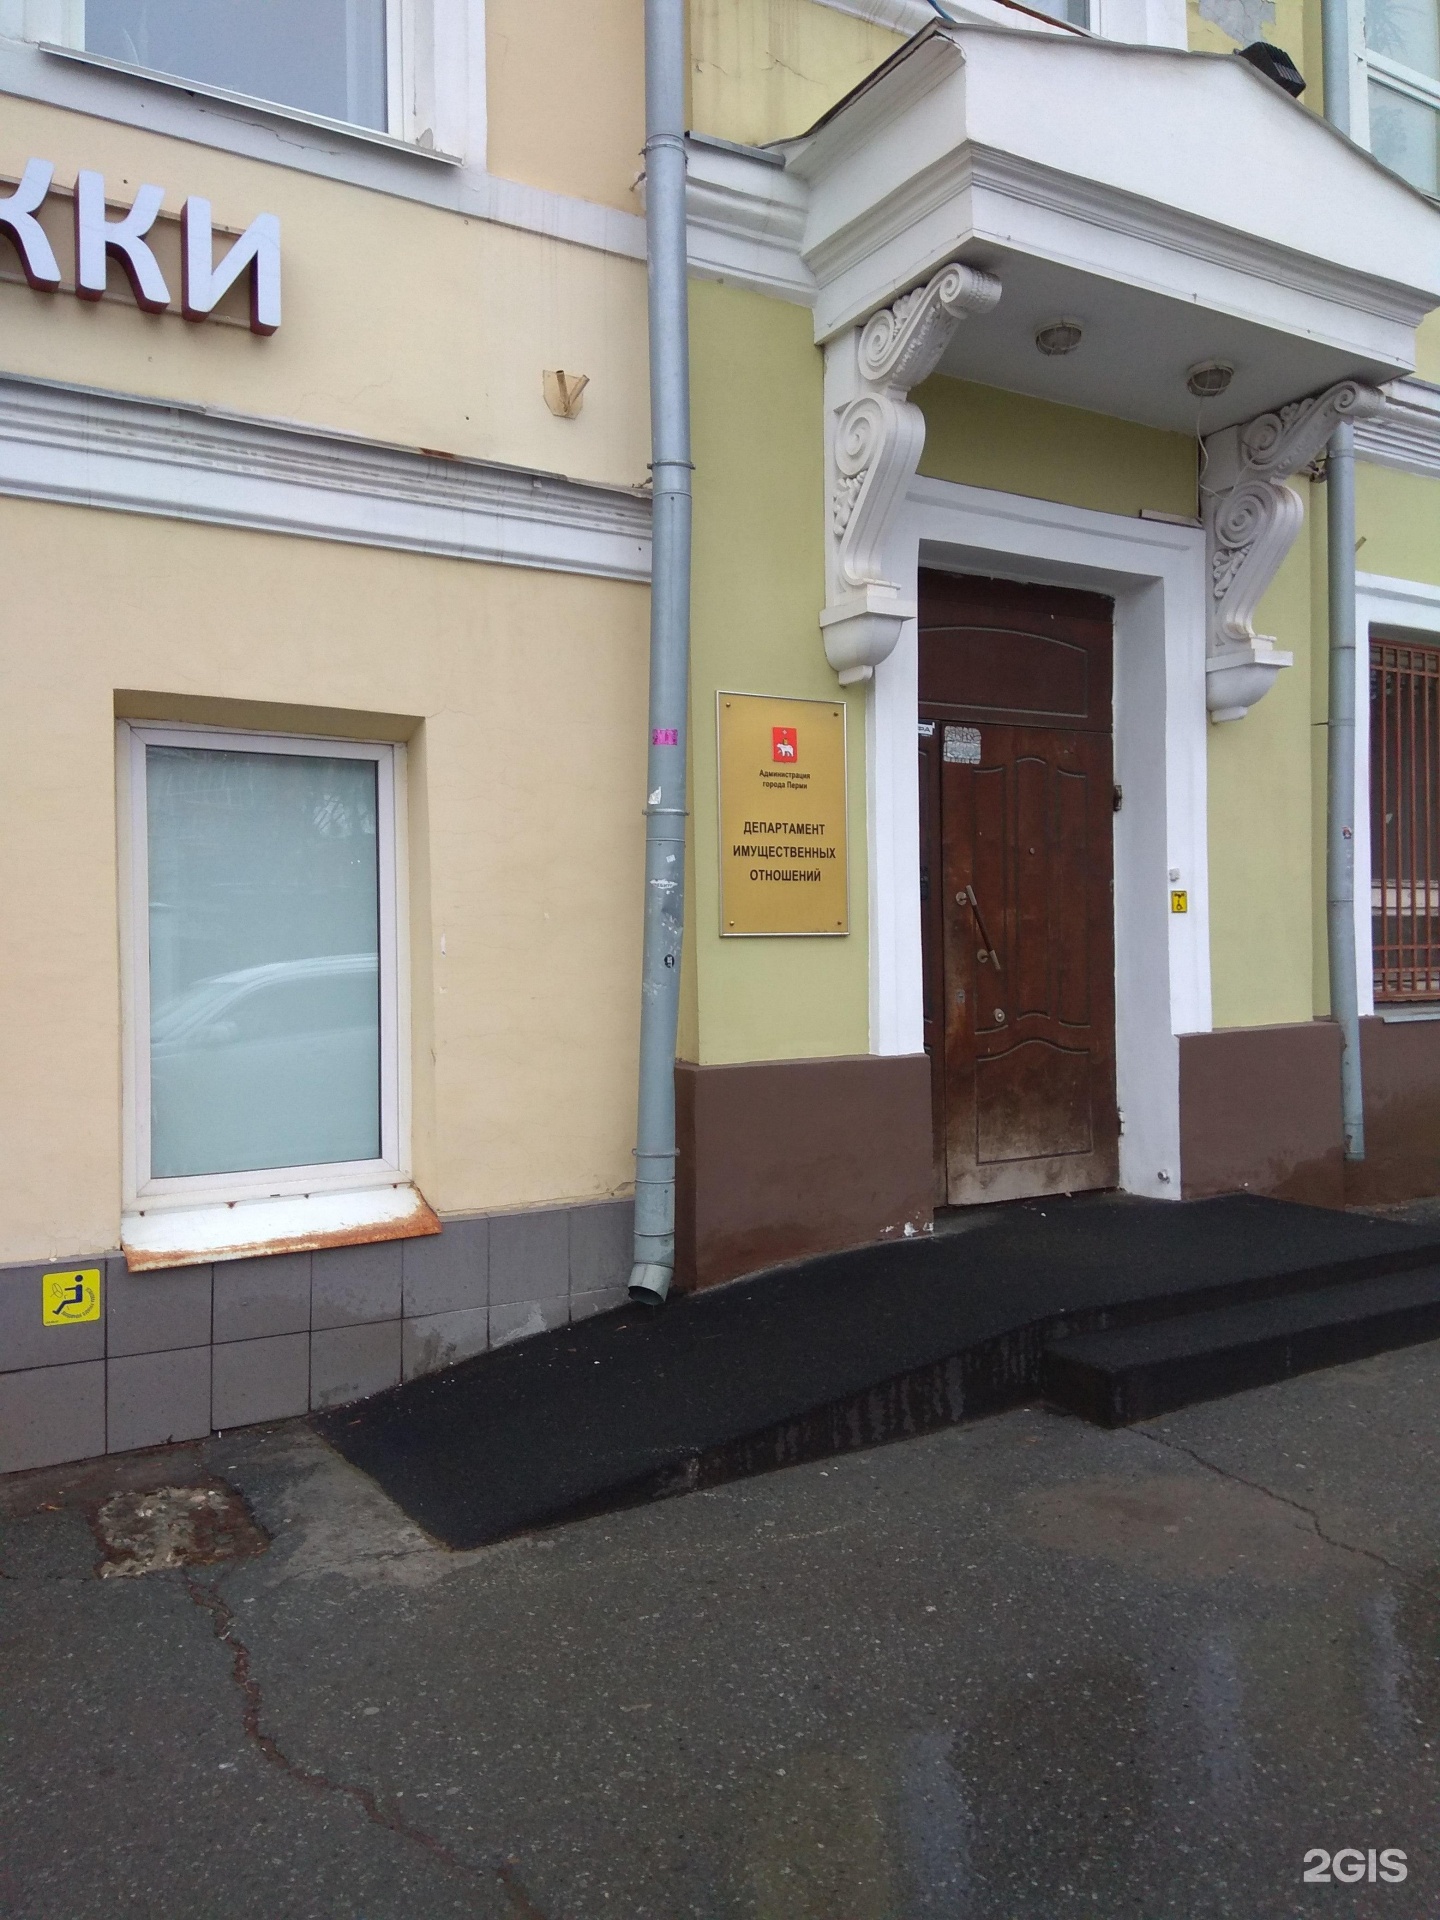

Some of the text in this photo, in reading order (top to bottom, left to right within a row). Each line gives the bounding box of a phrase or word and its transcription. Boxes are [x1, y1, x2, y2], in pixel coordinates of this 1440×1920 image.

[759, 769, 811, 779] Администрация
[762, 781, 808, 790] города Перми
[743, 821, 825, 835] ДЕПАРТАМЕНТ
[733, 844, 836, 859] ИМУЩЕСТВЕННЫХ
[749, 868, 821, 882] ОТНОШЕНИЙ
